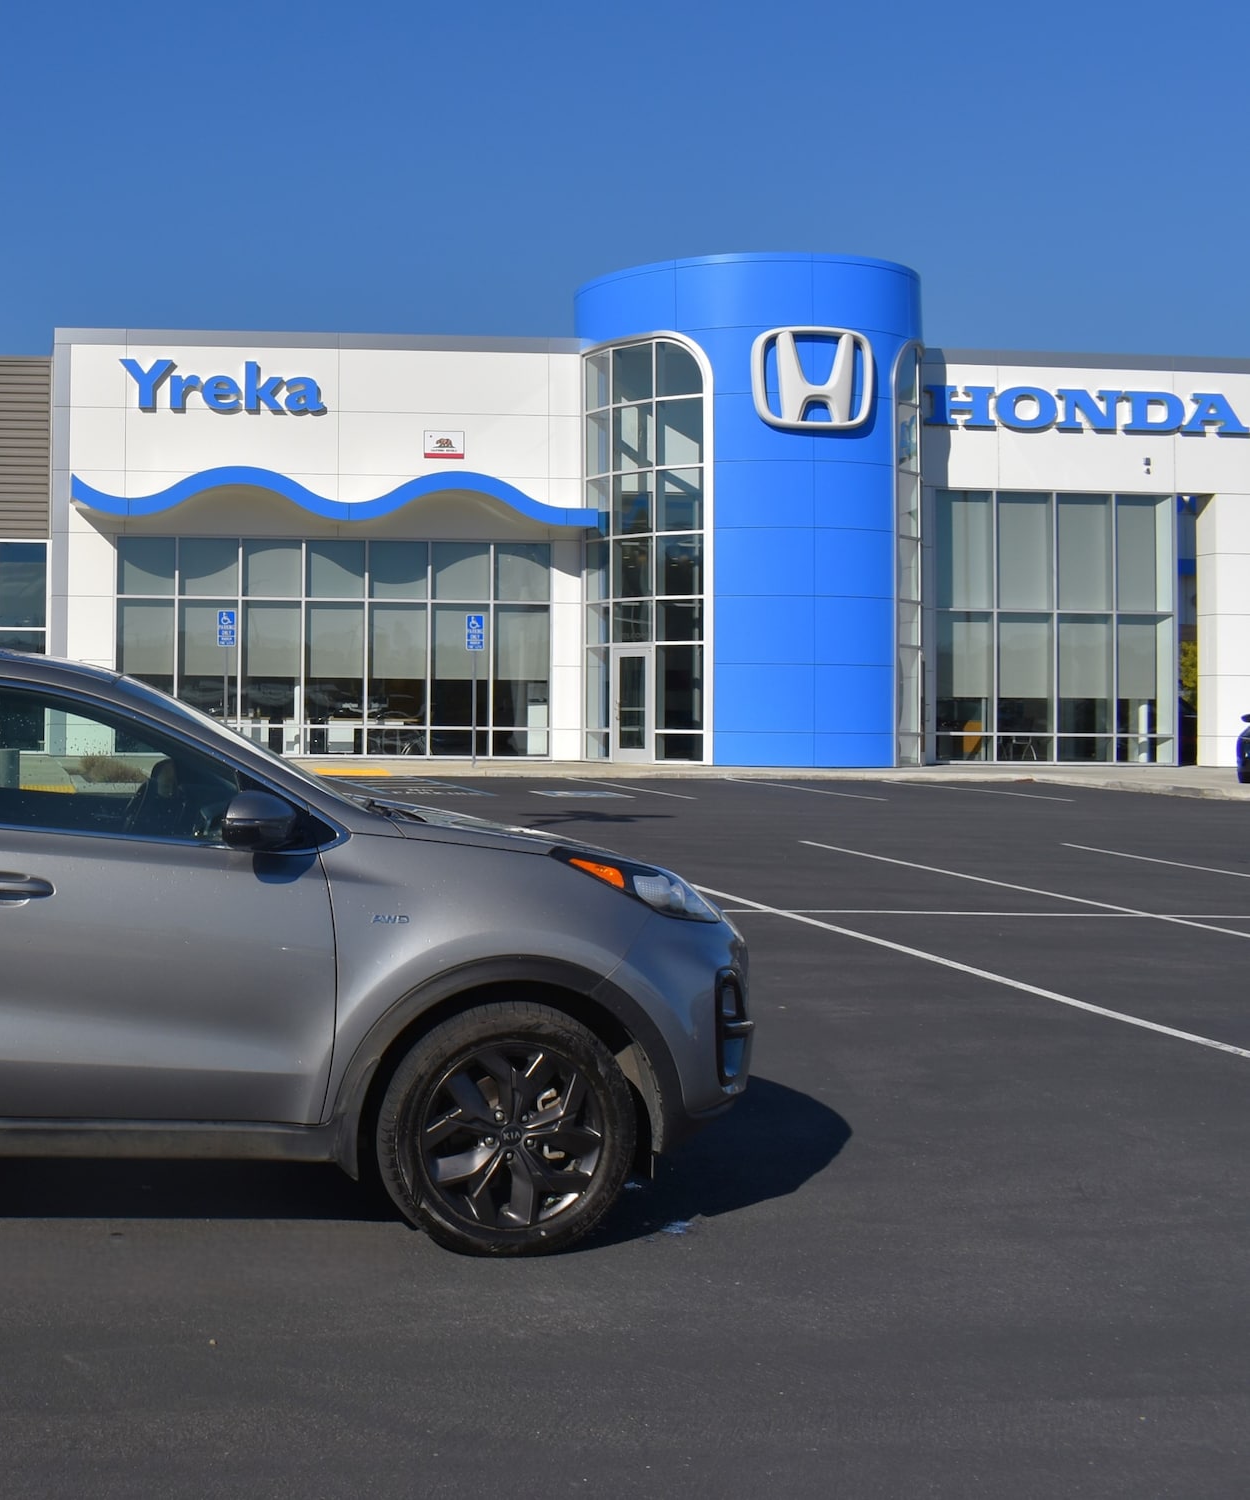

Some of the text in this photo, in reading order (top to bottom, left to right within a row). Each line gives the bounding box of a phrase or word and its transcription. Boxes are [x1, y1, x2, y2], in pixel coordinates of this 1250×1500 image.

[118, 358, 327, 416] Yreka
[923, 385, 1250, 437] HONDA
[371, 914, 410, 924] AWD
[503, 1131, 521, 1141] KIA
